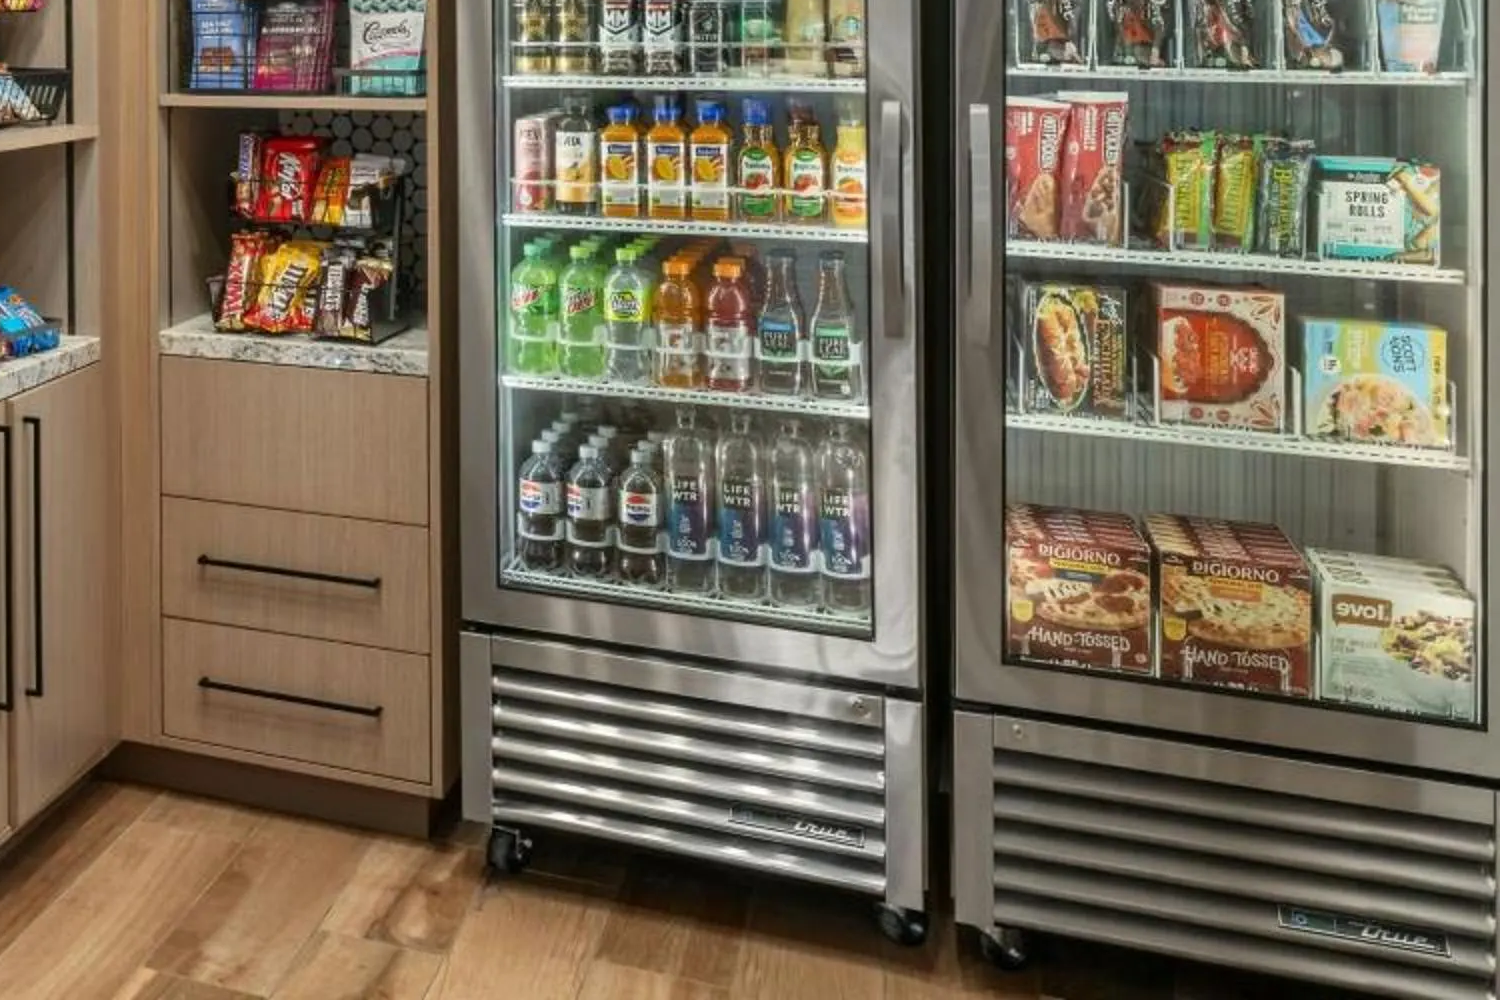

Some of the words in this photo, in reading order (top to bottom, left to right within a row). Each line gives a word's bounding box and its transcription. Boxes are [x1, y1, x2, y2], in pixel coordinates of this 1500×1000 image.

[1345, 189, 1389, 205] SPRING
[1349, 205, 1385, 218] ROLLS
[1039, 542, 1120, 566] DIGIORNO
[1192, 560, 1280, 583] DIGIORNO
[1180, 644, 1229, 667] HAND
[1230, 650, 1289, 672] TOSSED
